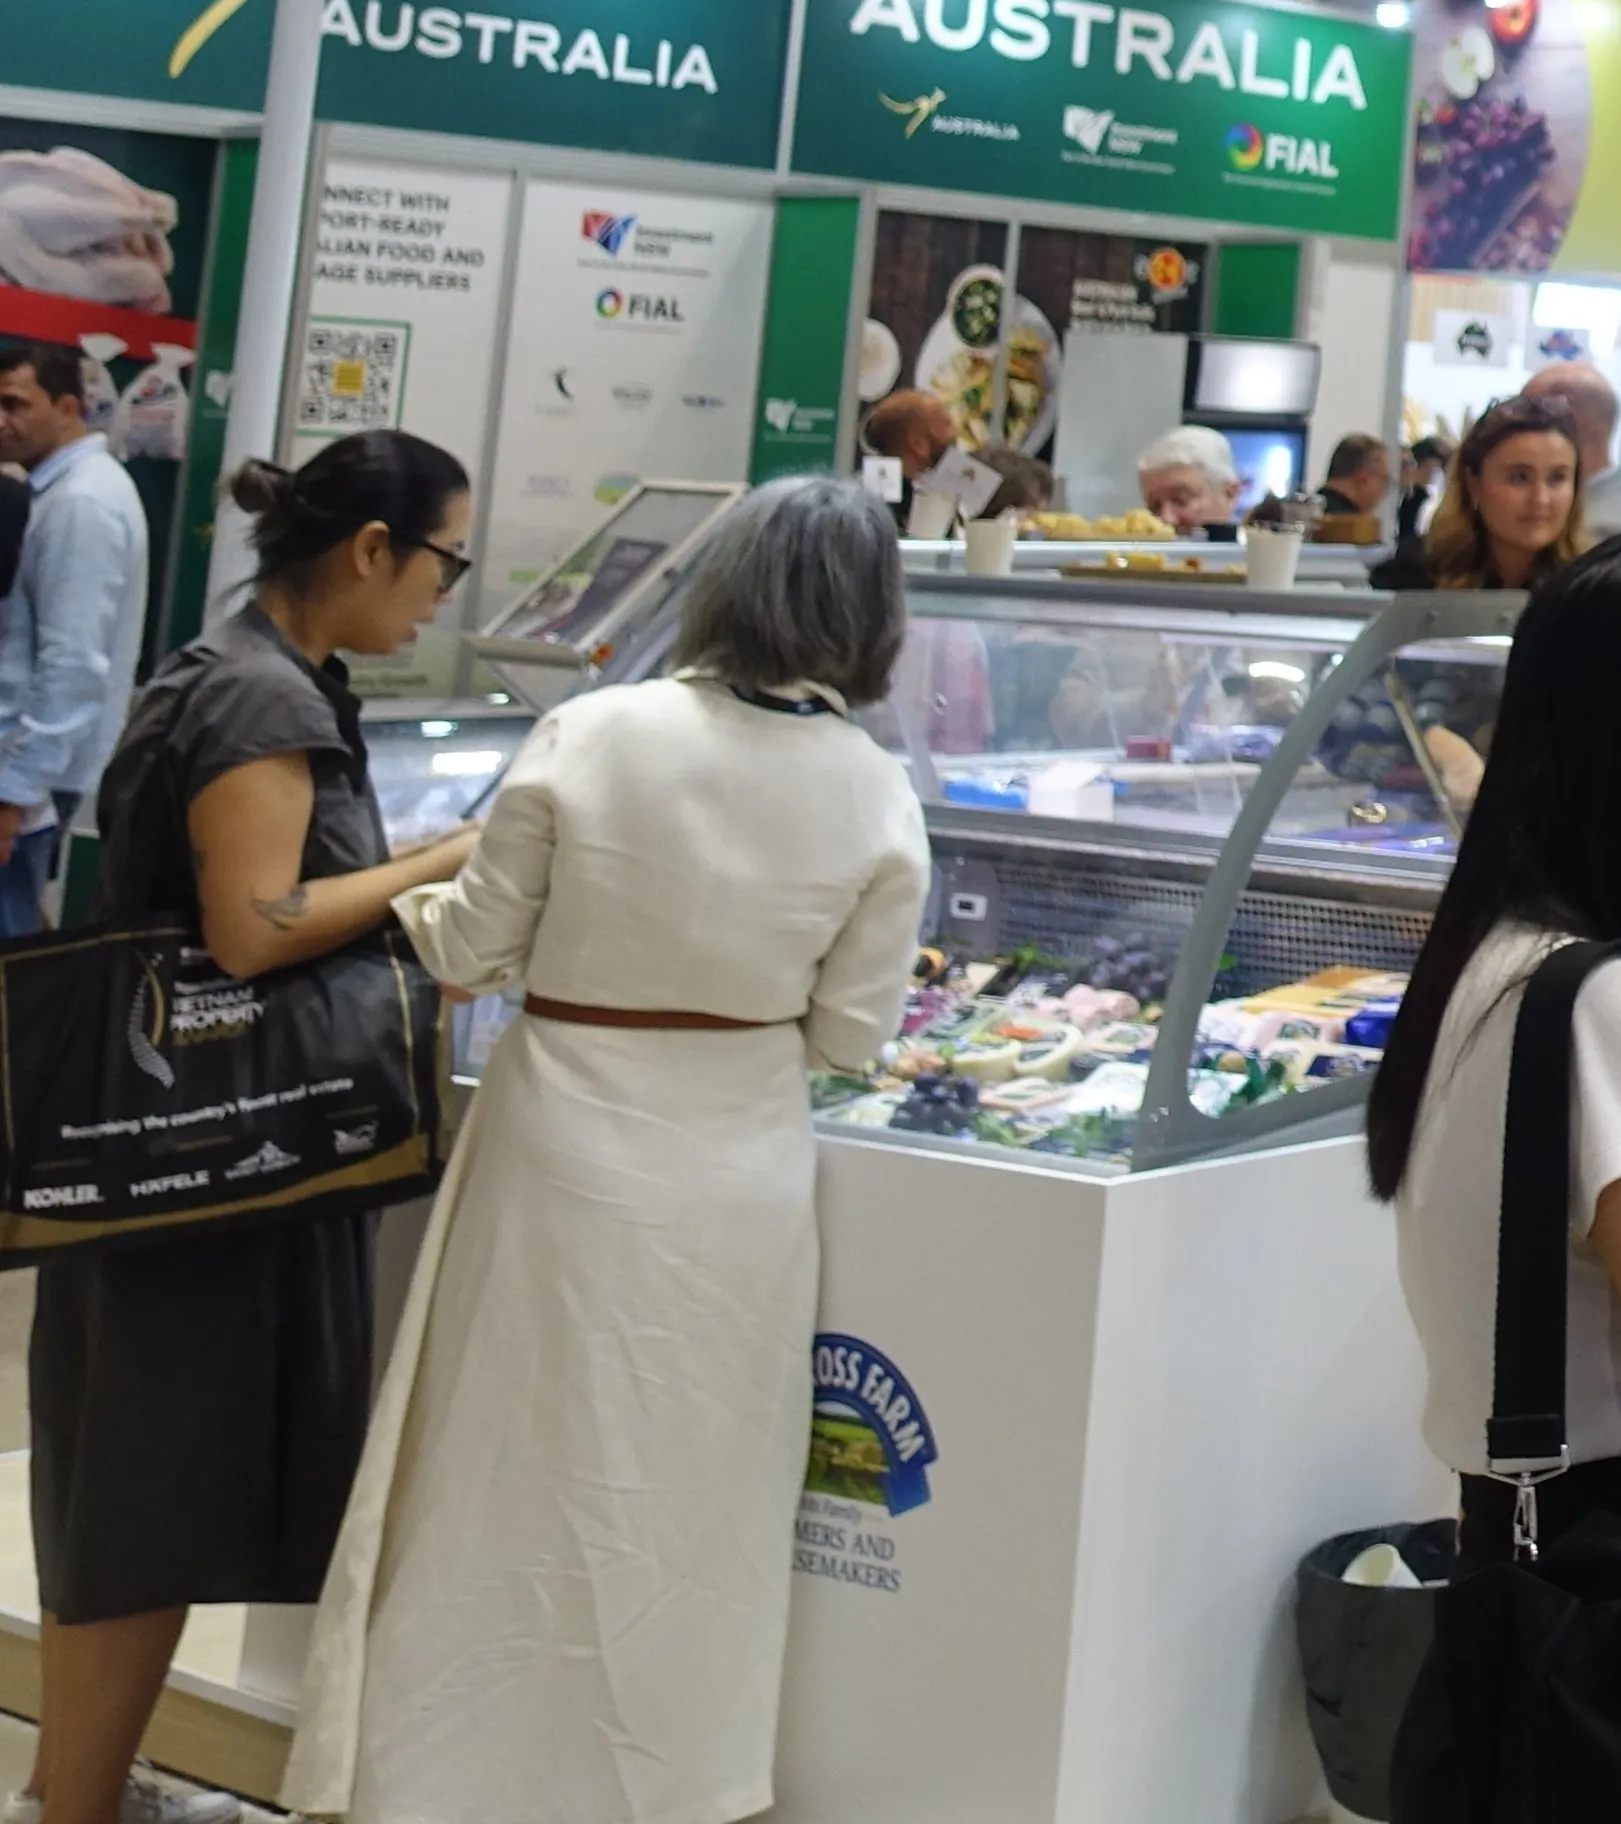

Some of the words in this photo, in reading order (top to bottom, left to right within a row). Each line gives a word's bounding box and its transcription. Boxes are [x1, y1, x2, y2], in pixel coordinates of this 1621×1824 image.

[931, 114, 1021, 141] AUSTRALIA
[1264, 132, 1339, 179] FIAL
[323, 185, 393, 208] NNECT
[400, 190, 451, 212] WITH
[321, 209, 446, 238] ORT-READY
[318, 238, 371, 257] LIAN
[377, 242, 437, 265] FOOD
[442, 247, 486, 269] AND
[316, 262, 359, 285] AGE
[364, 264, 472, 293] SUPPLIERS
[628, 294, 686, 322] FIAL
[815, 1345, 863, 1391] OSS
[859, 1363, 926, 1463] FARM
[794, 1518, 847, 1553] MERS
[850, 1532, 896, 1562] AND
[792, 1549, 902, 1594] SEMAKERS
